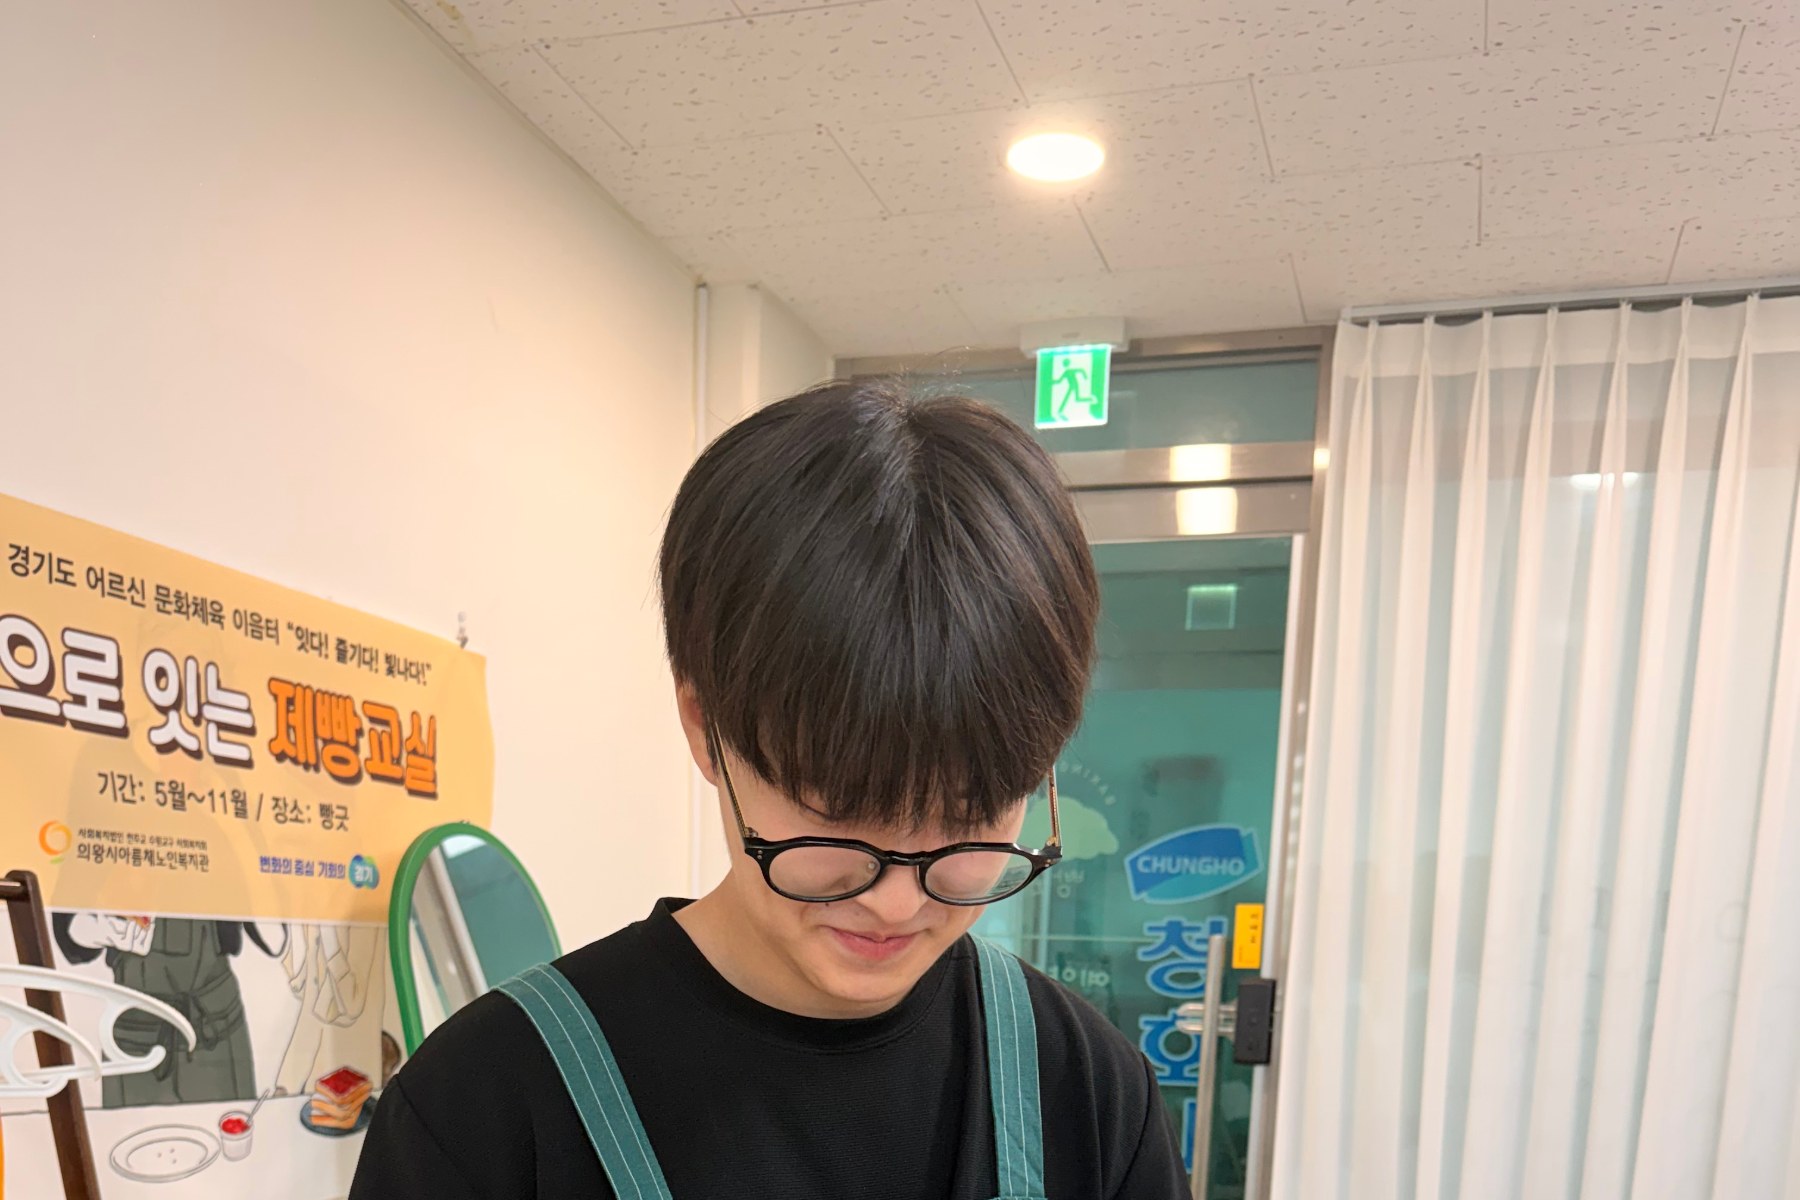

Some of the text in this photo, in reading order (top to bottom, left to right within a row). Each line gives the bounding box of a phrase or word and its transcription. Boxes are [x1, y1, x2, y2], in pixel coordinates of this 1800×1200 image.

[8, 543, 77, 587] 경기도
[86, 565, 146, 608] 어르신
[154, 584, 225, 631] 문화체육
[232, 609, 280, 645] 이음터
[335, 636, 379, 674] 즐기다!
[0, 613, 438, 799] 으로 잇는 제빵교실
[97, 771, 145, 804] 기간:
[154, 780, 248, 819] 5월~11월
[272, 796, 311, 824] 장소:
[319, 803, 349, 832] 빵긋
[259, 856, 292, 875] 변화의
[318, 861, 346, 879] 기회의
[354, 865, 373, 882] 경기
[1136, 855, 1245, 876] CHUNGHO
